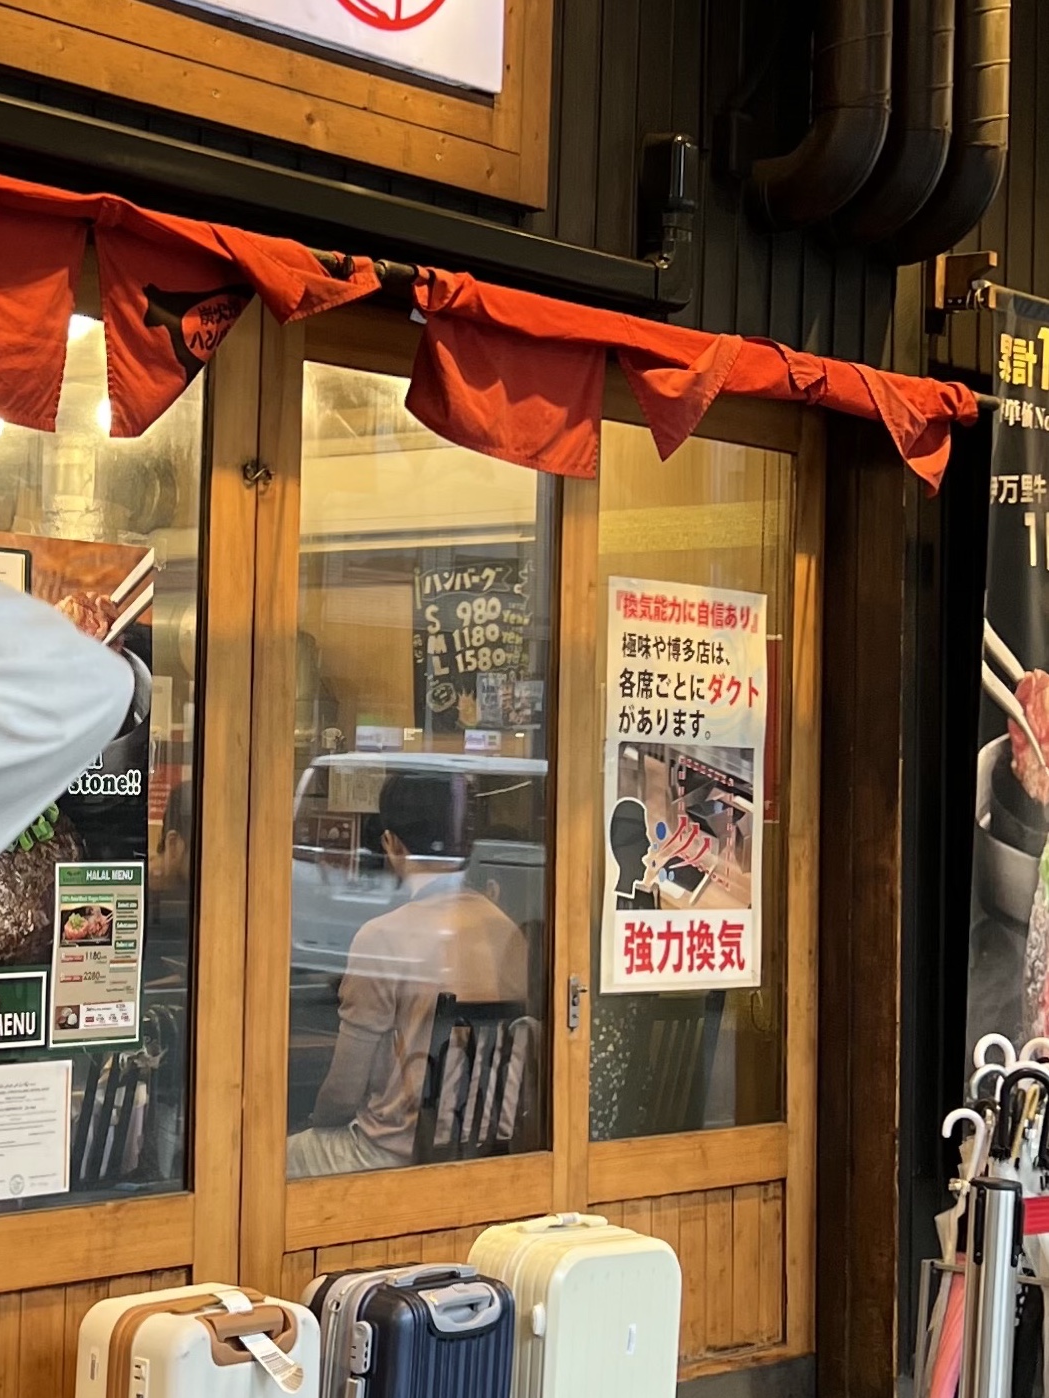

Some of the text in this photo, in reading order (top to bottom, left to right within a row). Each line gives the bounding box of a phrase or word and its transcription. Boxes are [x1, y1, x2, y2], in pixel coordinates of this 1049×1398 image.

[424, 567, 503, 595] ハンバーグ
[425, 605, 441, 634] S
[456, 597, 501, 627] 980
[427, 633, 447, 655] M
[432, 655, 449, 676] L
[455, 647, 506, 673] 1580
[622, 631, 731, 666] 極味や博多店は、
[619, 667, 759, 708] 各席ごとにダクト
[618, 704, 711, 741] があります。
[86, 869, 134, 881] HALAL MENU
[624, 920, 746, 975] 強力換気
